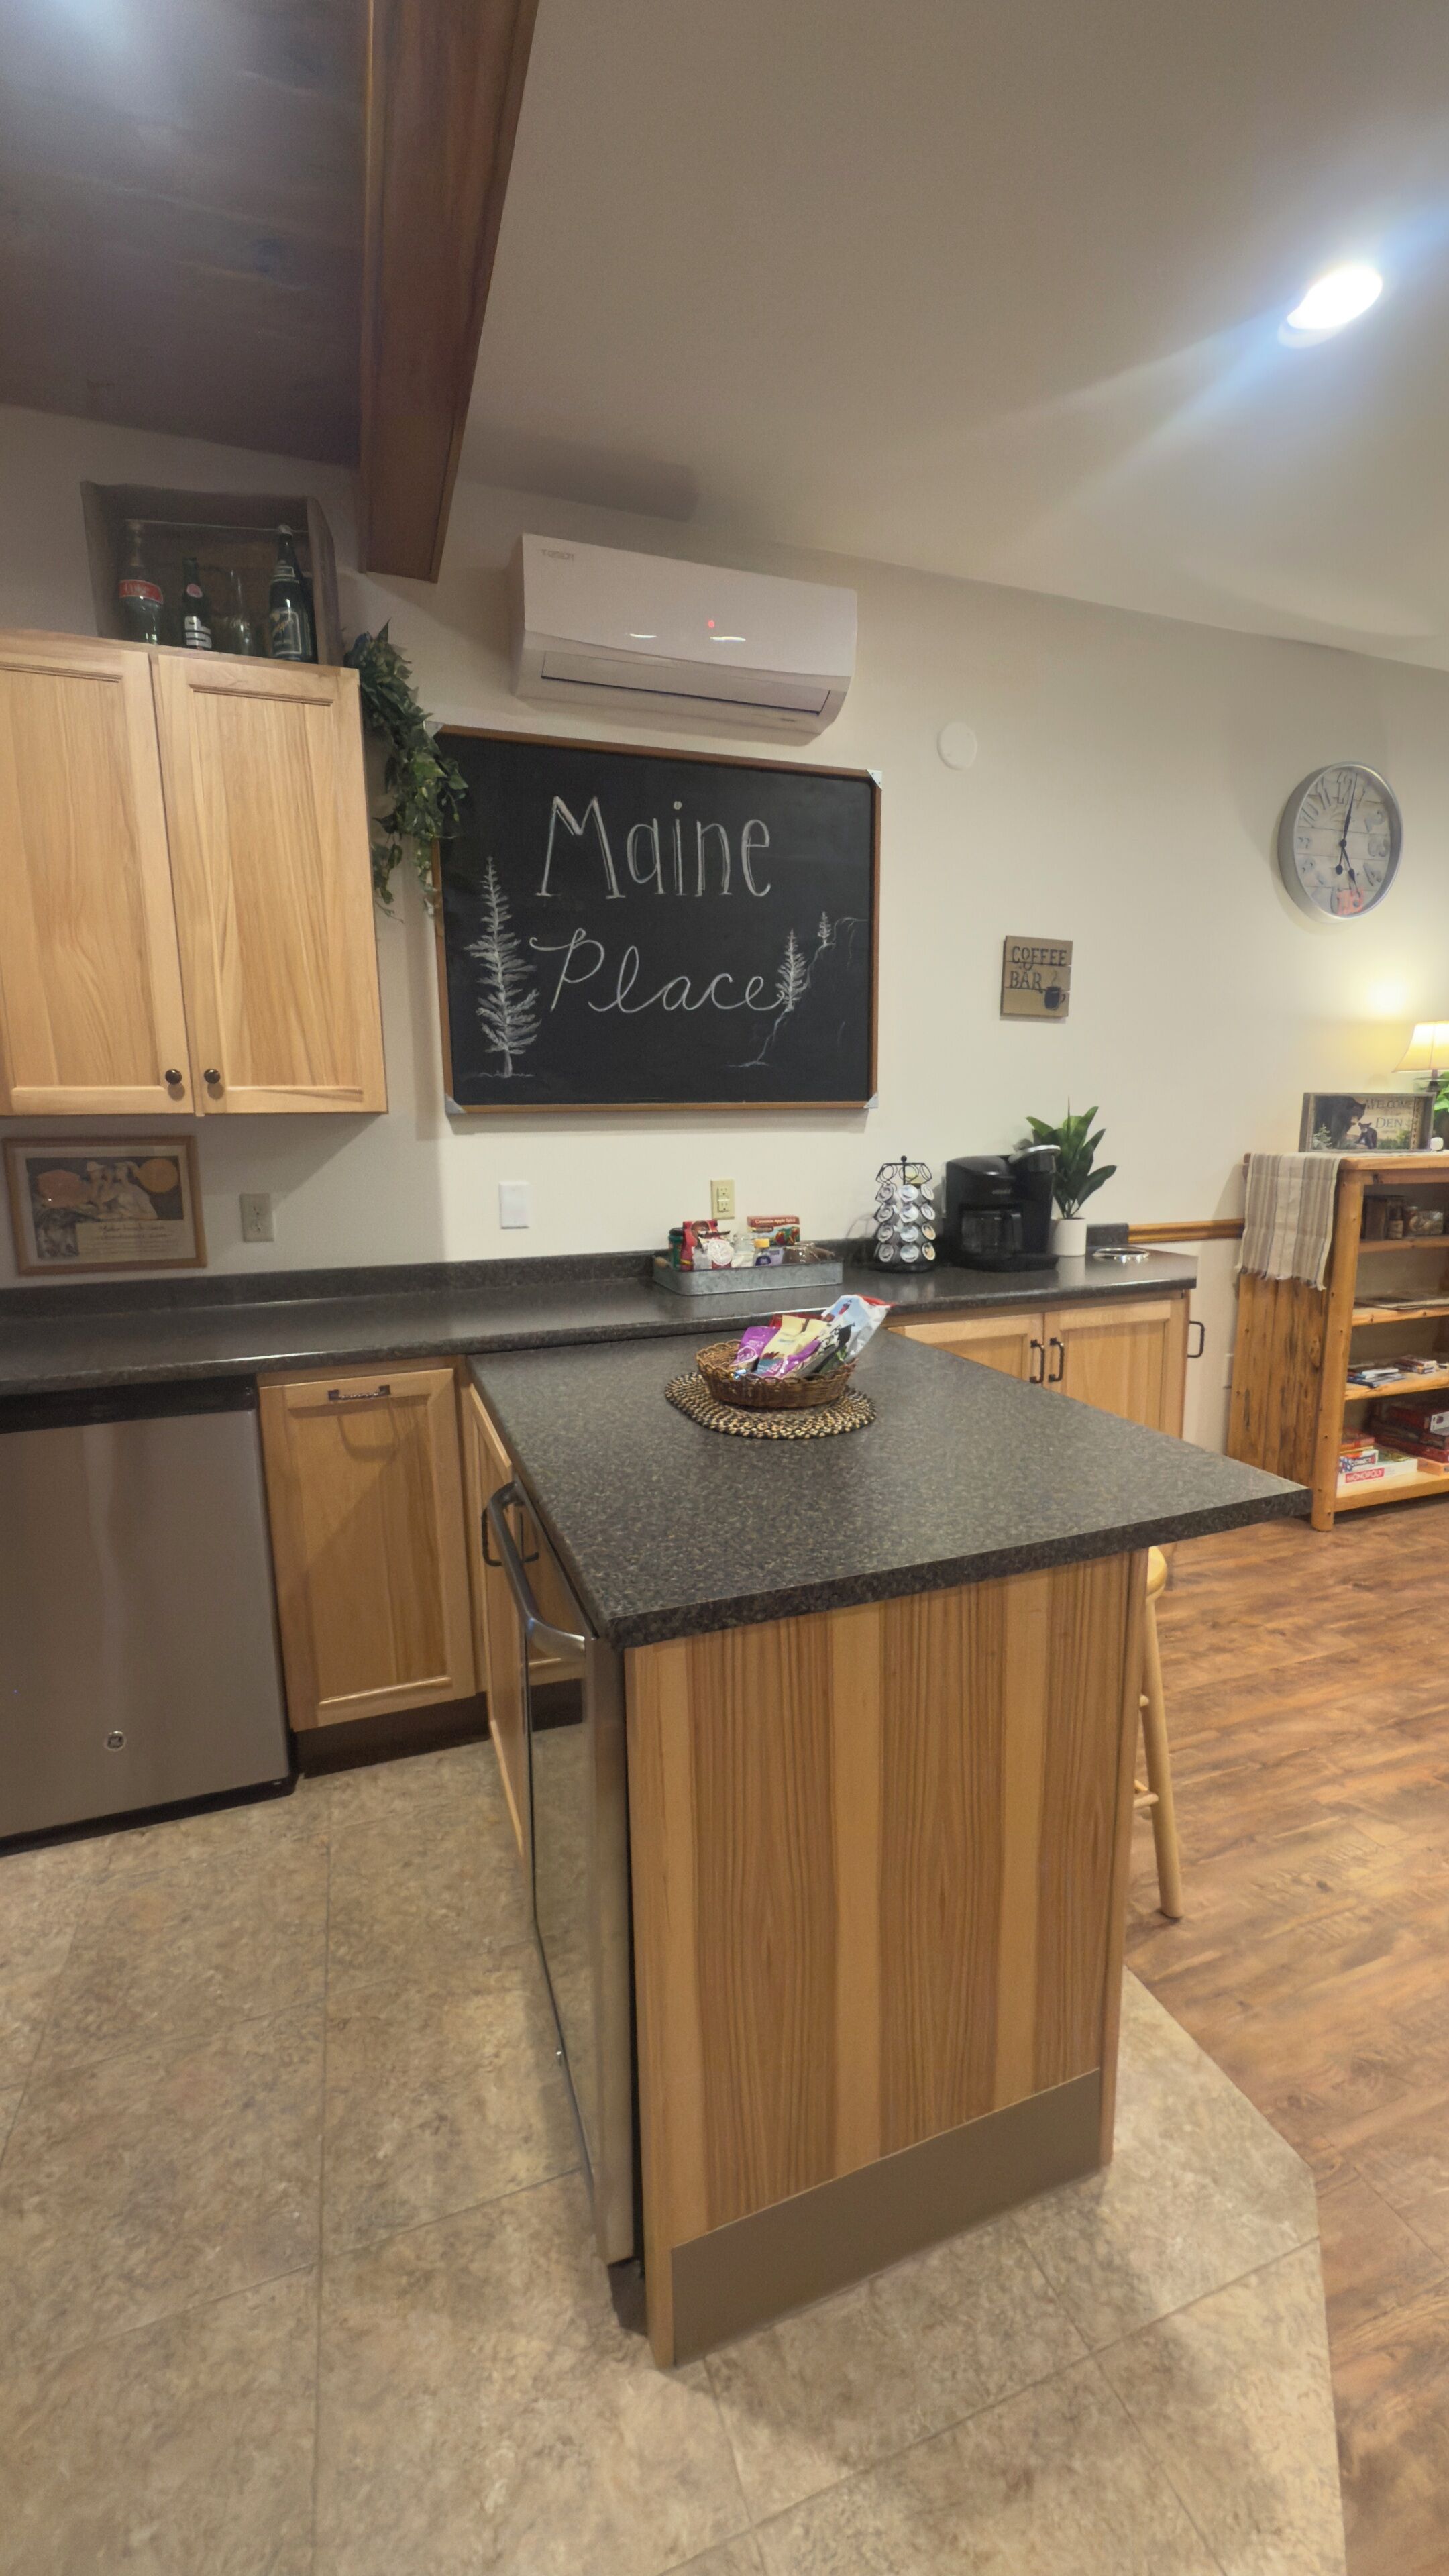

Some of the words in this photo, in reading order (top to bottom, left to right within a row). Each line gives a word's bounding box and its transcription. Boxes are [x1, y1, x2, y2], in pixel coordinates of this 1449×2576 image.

[535, 796, 772, 900] Maine
[1012, 945, 1067, 967] COFFEE
[529, 927, 786, 1014] Place
[1010, 971, 1043, 994] BAR
[1346, 1469, 1383, 1482] MONOPOLY
